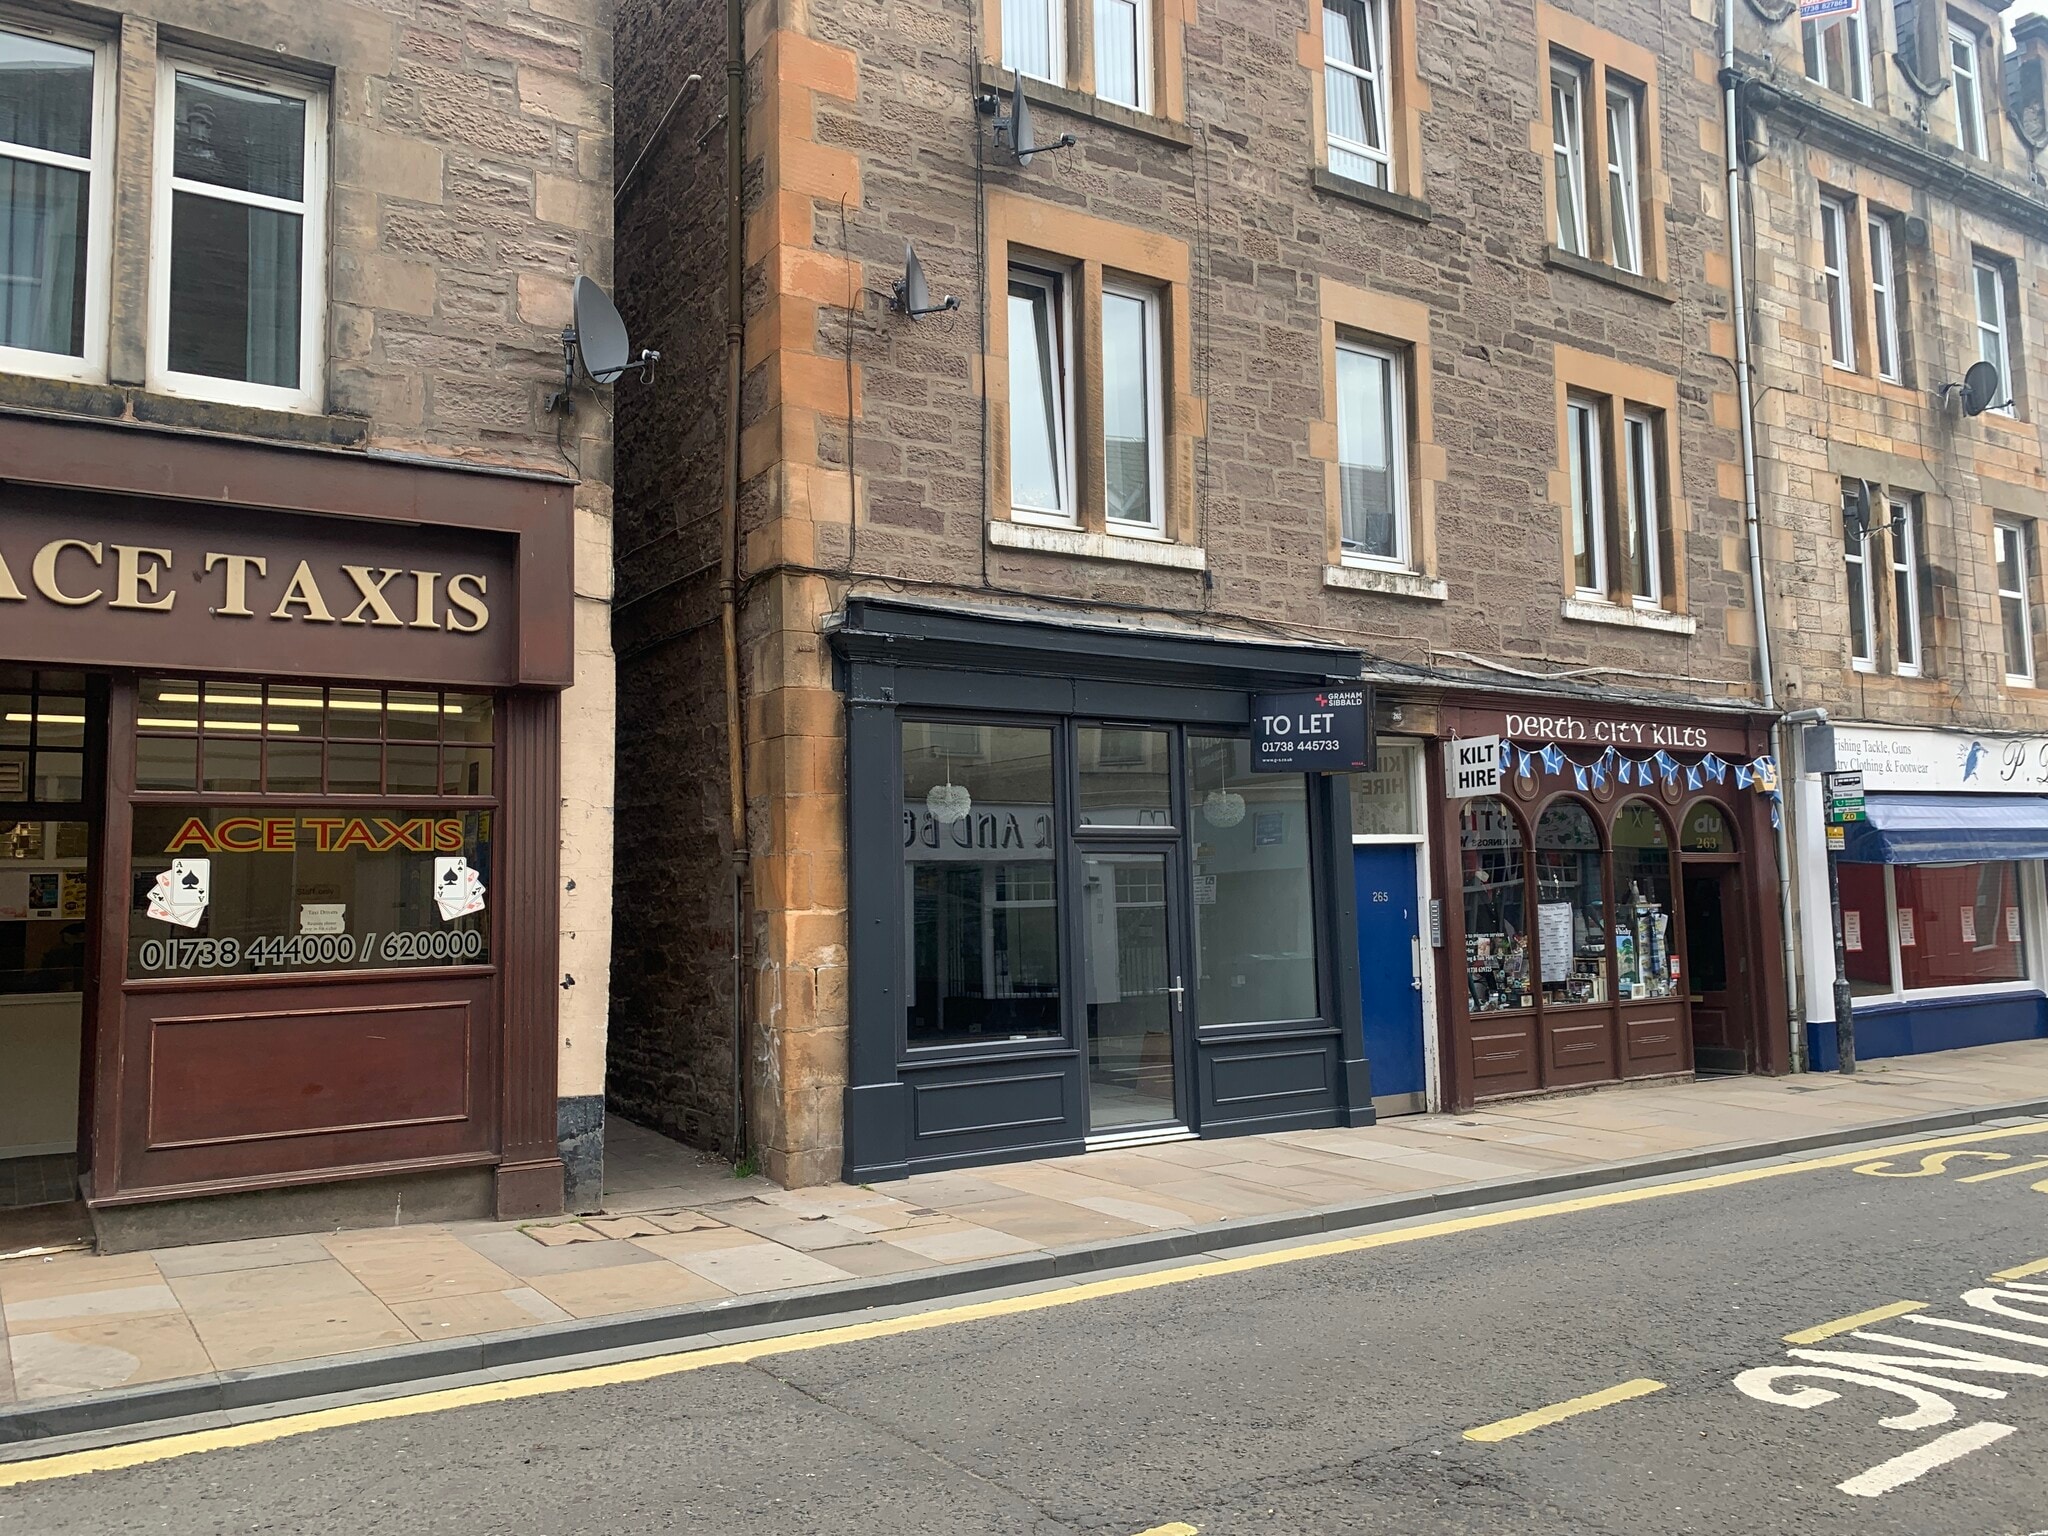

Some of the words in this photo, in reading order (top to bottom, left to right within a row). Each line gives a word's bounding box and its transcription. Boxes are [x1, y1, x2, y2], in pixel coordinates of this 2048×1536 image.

[205, 552, 490, 632] TAXIS
[1328, 692, 1362, 700] GRAHAM
[1262, 715, 1291, 735] TO
[1299, 713, 1334, 734] LET
[1262, 741, 1293, 752] 01738
[1297, 740, 1339, 751] 445733
[1460, 744, 1494, 766] KILT
[1863, 740, 1890, 755] Tackle,
[1891, 741, 1912, 755] Guns
[1850, 758, 1884, 775] Clothing
[1885, 760, 1893, 772] &
[1894, 760, 1928, 774] Footwear
[1458, 768, 1497, 789] HIRE
[164, 817, 297, 852] ACE
[302, 817, 464, 851] TAXIS
[1695, 837, 1717, 849] 263
[1373, 891, 1388, 902] 265
[139, 937, 240, 971] 01738
[245, 933, 356, 967] 444000
[359, 933, 376, 962] /
[380, 930, 481, 961] 620000
